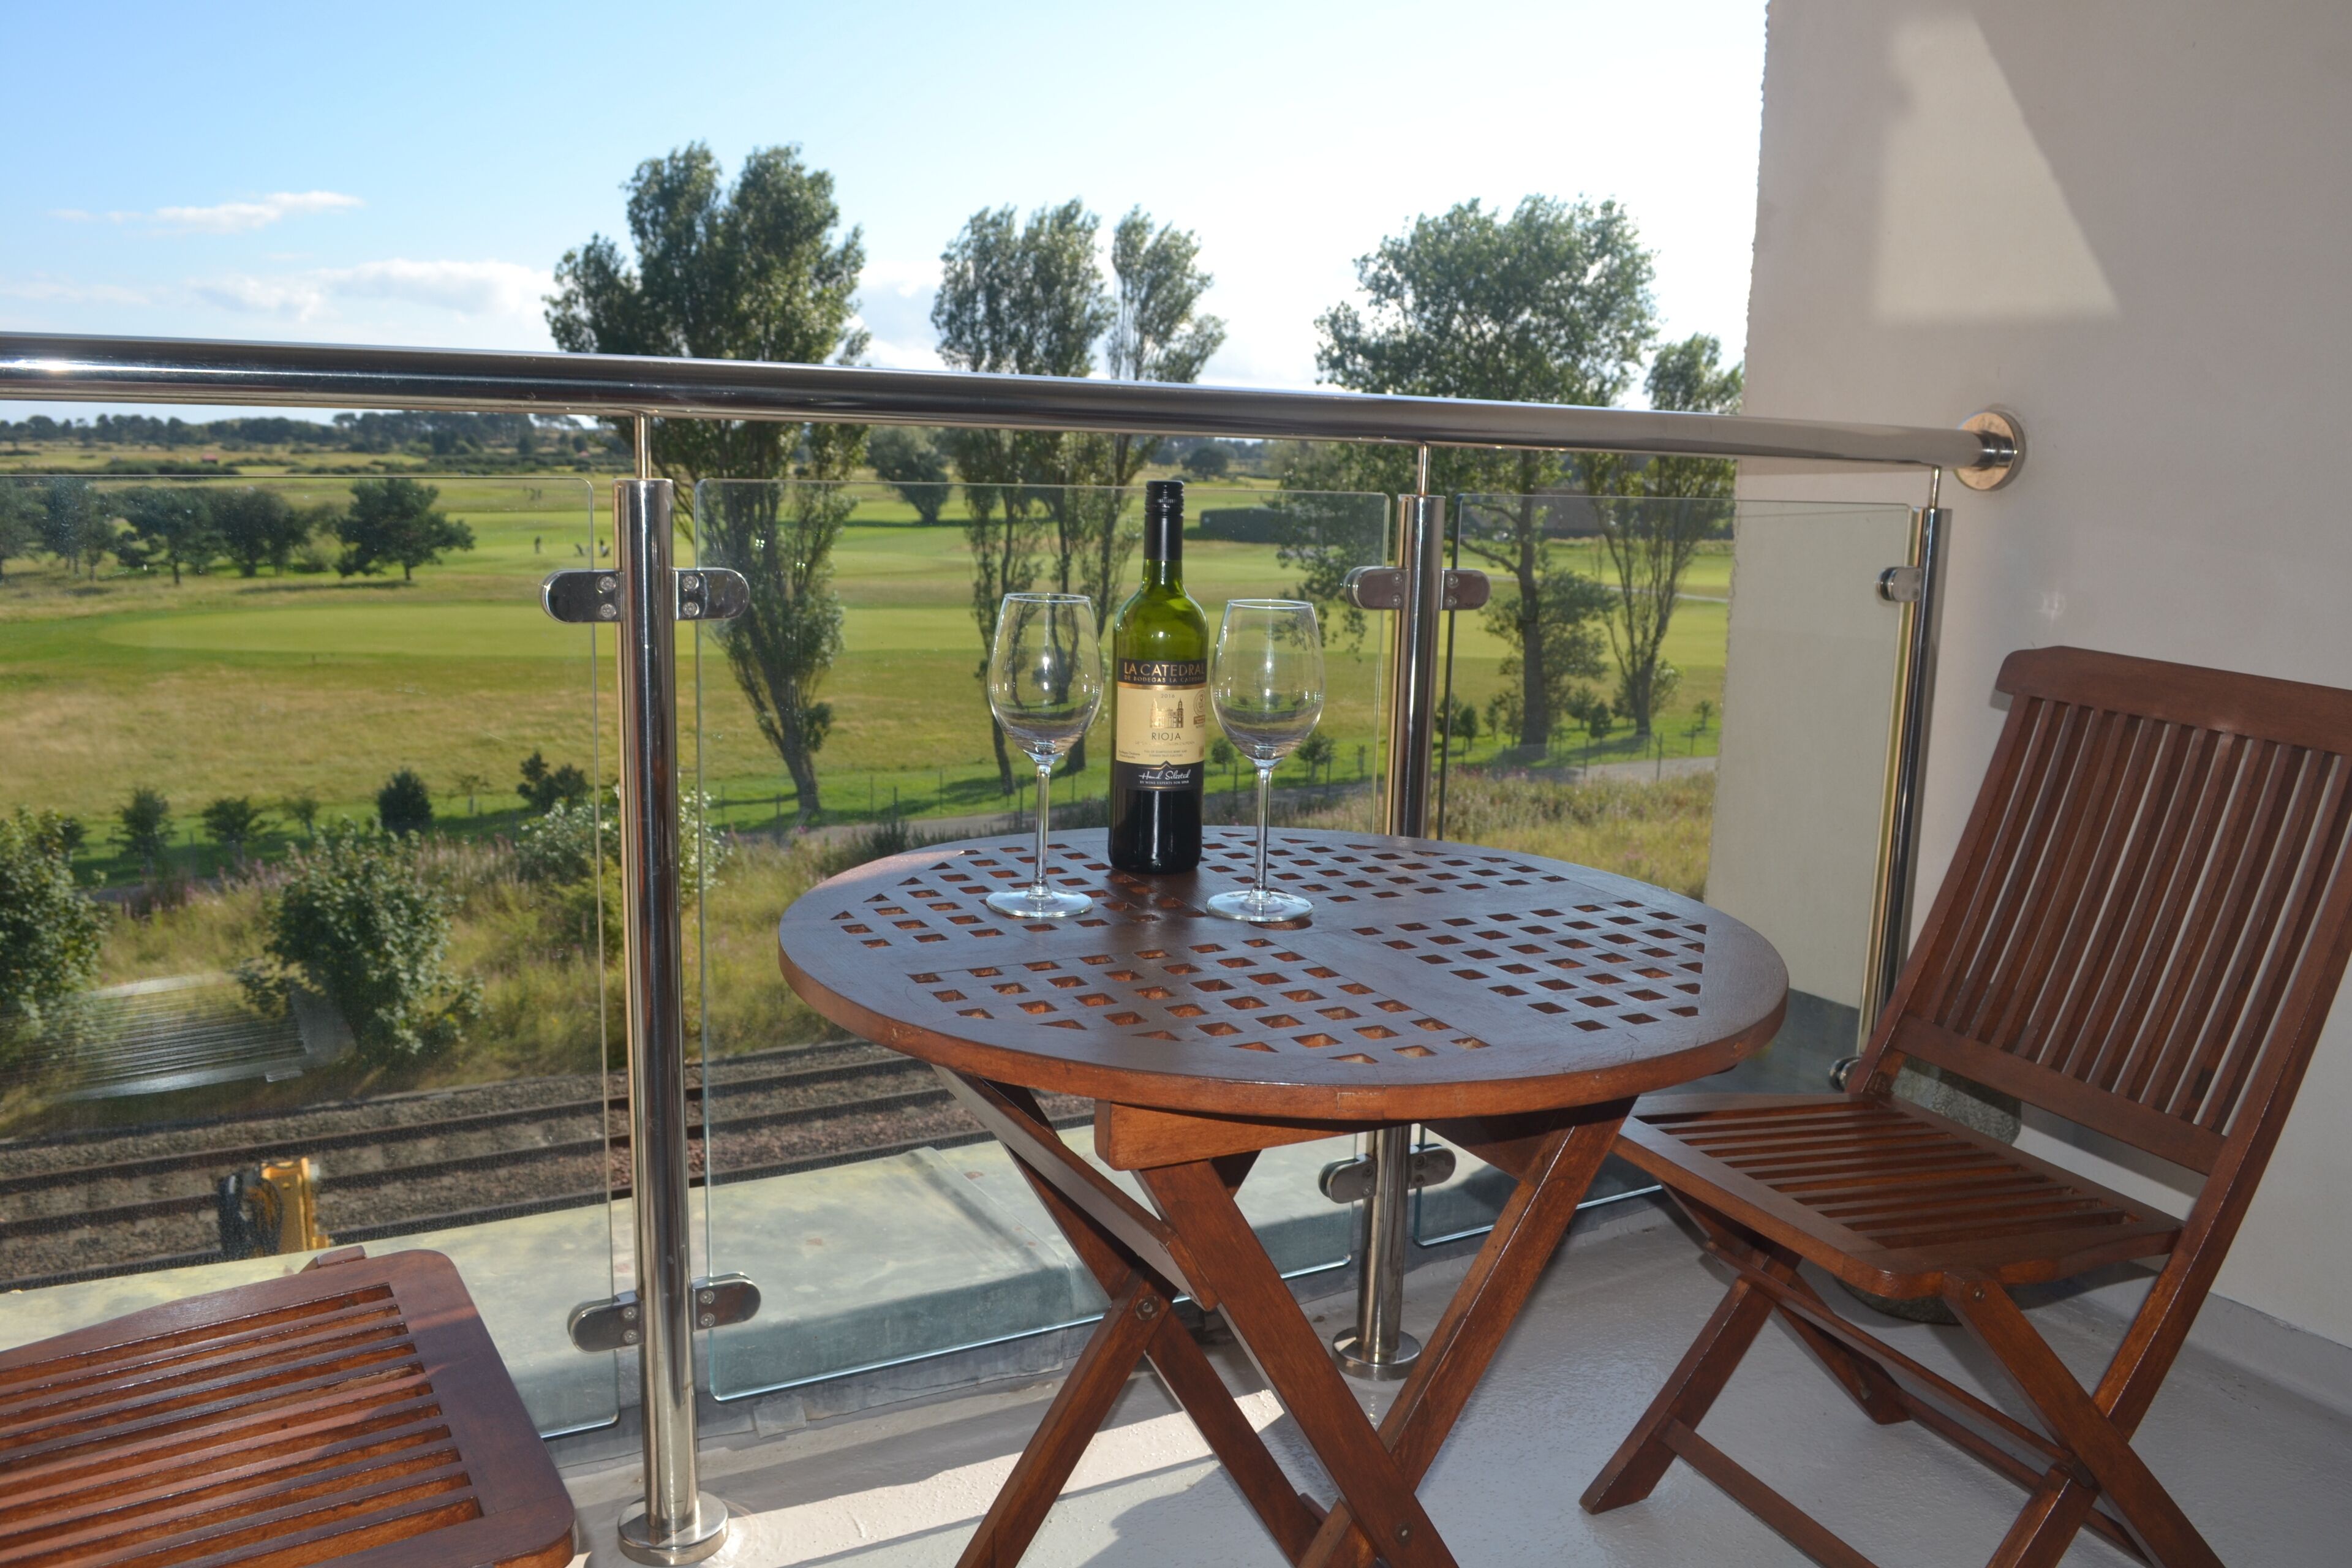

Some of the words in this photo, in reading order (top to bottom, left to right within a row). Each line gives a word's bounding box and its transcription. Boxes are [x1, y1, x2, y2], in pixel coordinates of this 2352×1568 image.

[1124, 662, 1137, 675] LA
[1140, 663, 1205, 677] CATEDRAL
[1152, 732, 1182, 741] RIOJA
[1165, 769, 1191, 780] Selected
